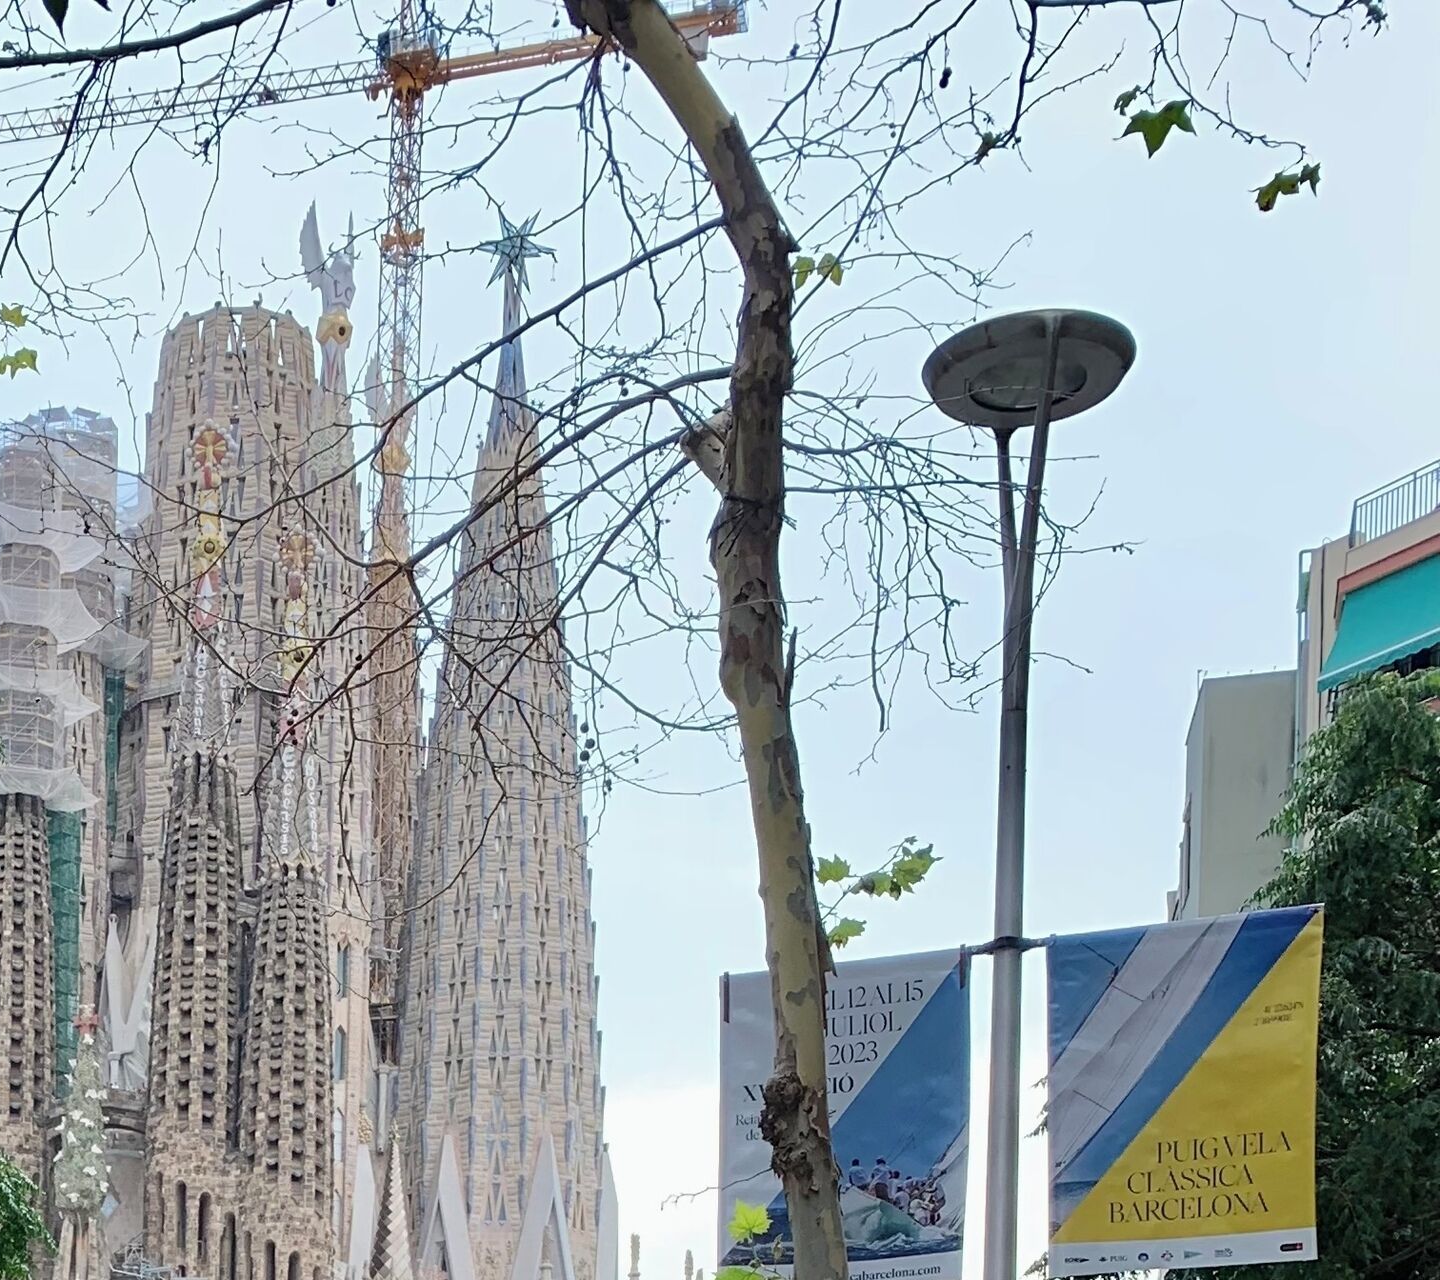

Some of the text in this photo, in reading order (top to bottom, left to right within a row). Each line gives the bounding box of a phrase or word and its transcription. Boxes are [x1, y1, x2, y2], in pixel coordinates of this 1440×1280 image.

[848, 986, 867, 1008] 12
[870, 983, 902, 1006] AL
[905, 979, 924, 1002] 15
[829, 1041, 878, 1066] 2023
[1157, 1130, 1292, 1164] PUIG VELA
[1127, 1163, 1254, 1195] CLÀSSICA
[1109, 1191, 1270, 1224] BARCELONA
